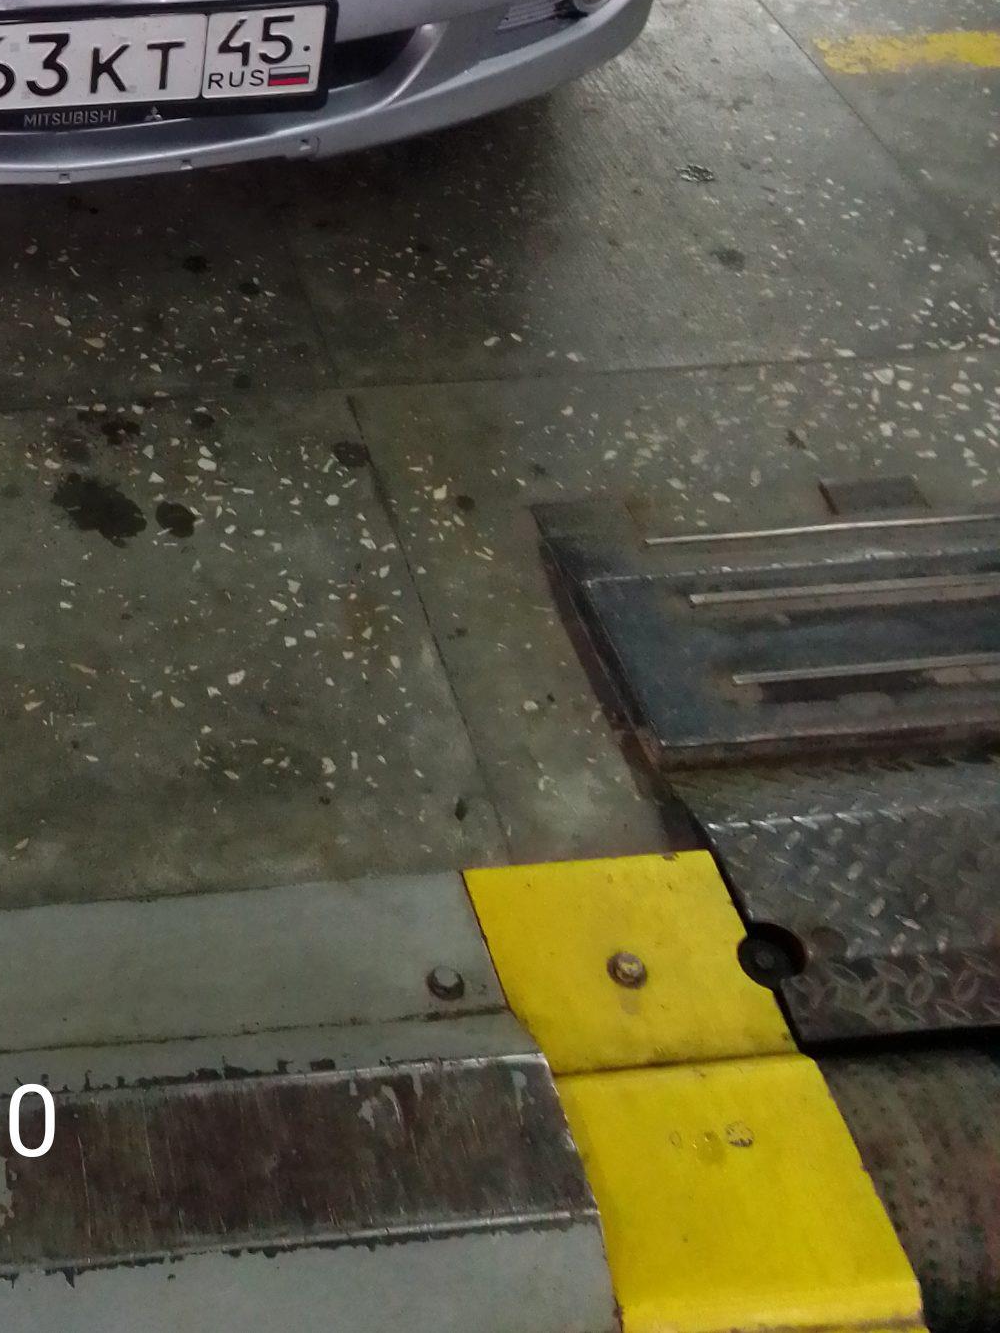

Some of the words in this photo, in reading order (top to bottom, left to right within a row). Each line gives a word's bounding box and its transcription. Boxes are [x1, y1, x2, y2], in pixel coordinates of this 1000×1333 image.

[217, 14, 295, 67] 45
[207, 69, 265, 90] RUS
[23, 109, 118, 127] MITSUBISHI
